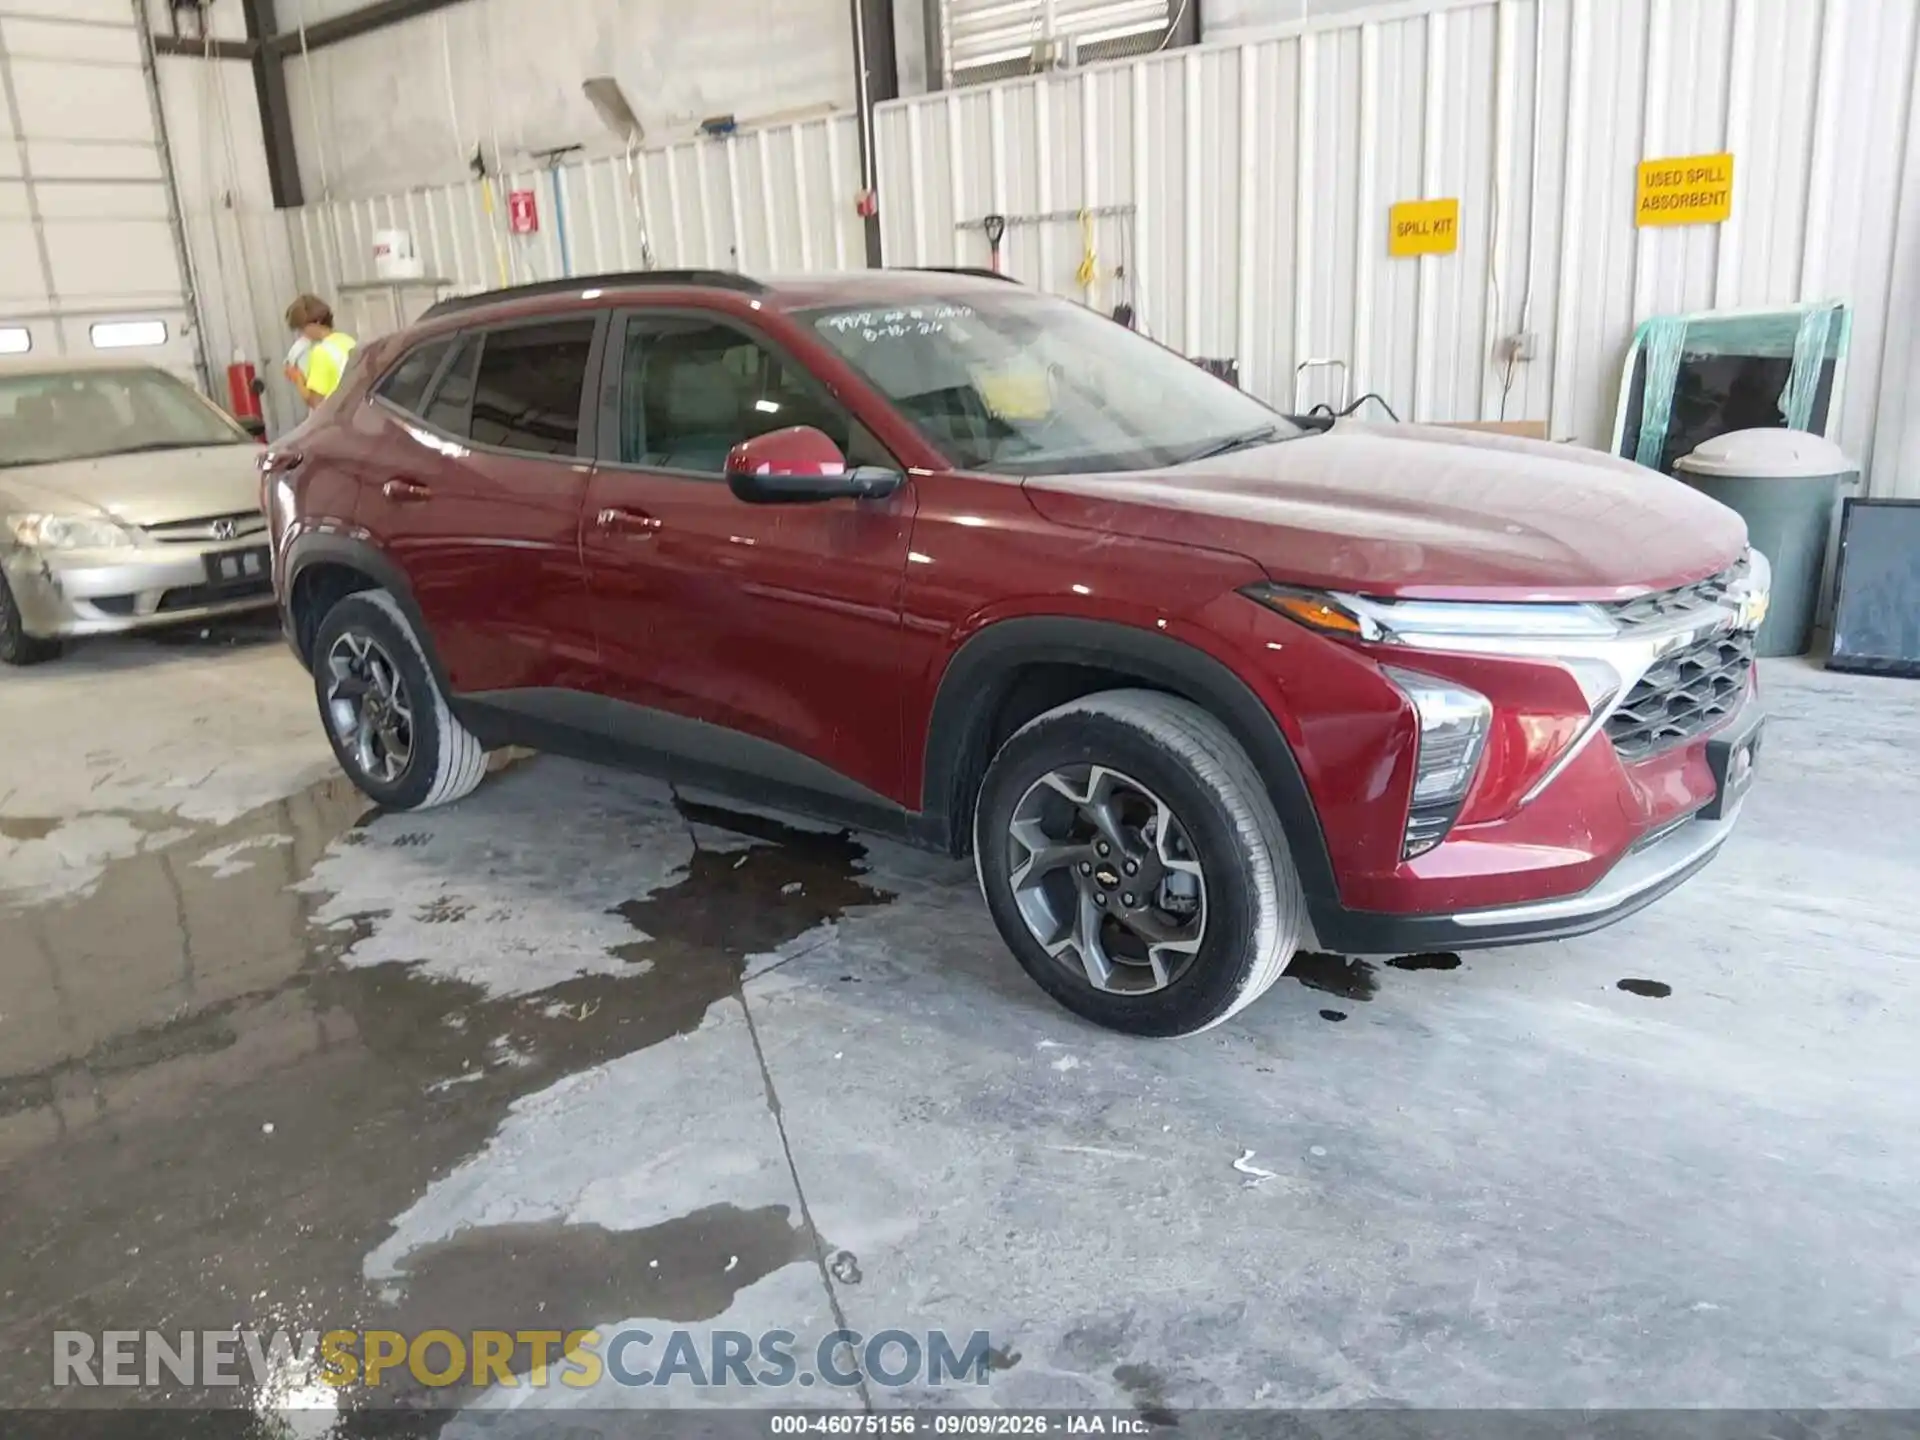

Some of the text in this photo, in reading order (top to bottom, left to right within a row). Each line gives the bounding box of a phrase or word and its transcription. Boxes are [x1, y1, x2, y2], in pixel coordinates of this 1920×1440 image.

[1646, 167, 1725, 187] USED SPILL
[1640, 190, 1727, 211] ABSORBENT
[1397, 217, 1453, 237] SPILL KIT
